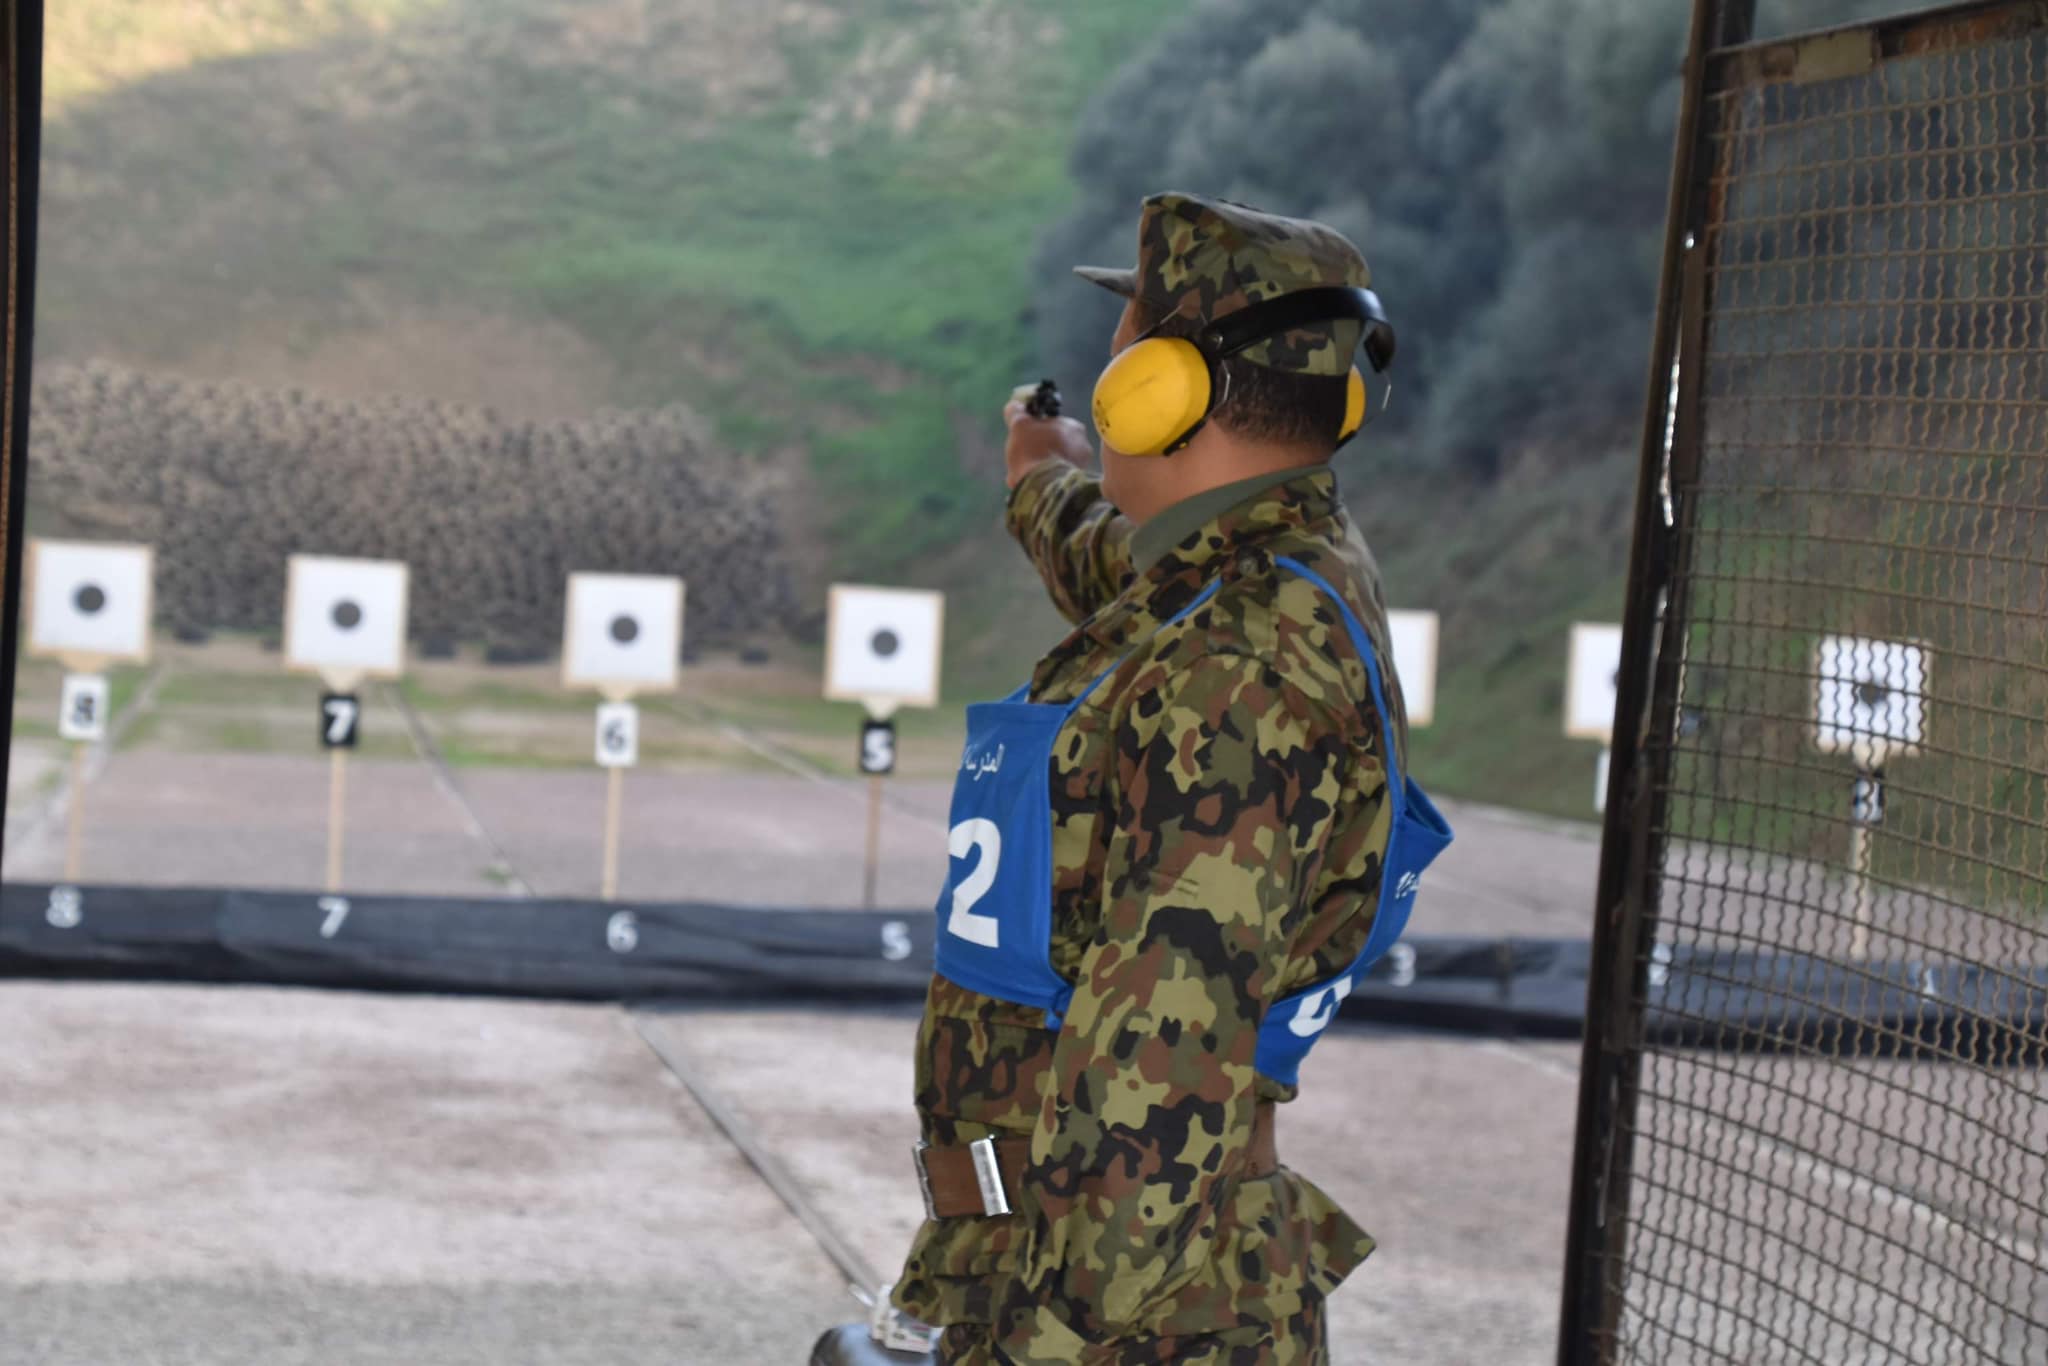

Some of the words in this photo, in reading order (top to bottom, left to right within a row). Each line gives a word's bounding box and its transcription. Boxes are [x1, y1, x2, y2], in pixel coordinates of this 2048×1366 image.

[323, 697, 357, 743] 7
[604, 716, 628, 754] 6
[861, 727, 895, 773] 5
[947, 816, 1001, 948] 2
[45, 886, 83, 928] 8
[317, 896, 350, 939] 7
[606, 910, 639, 954] 6
[881, 920, 912, 961] 5
